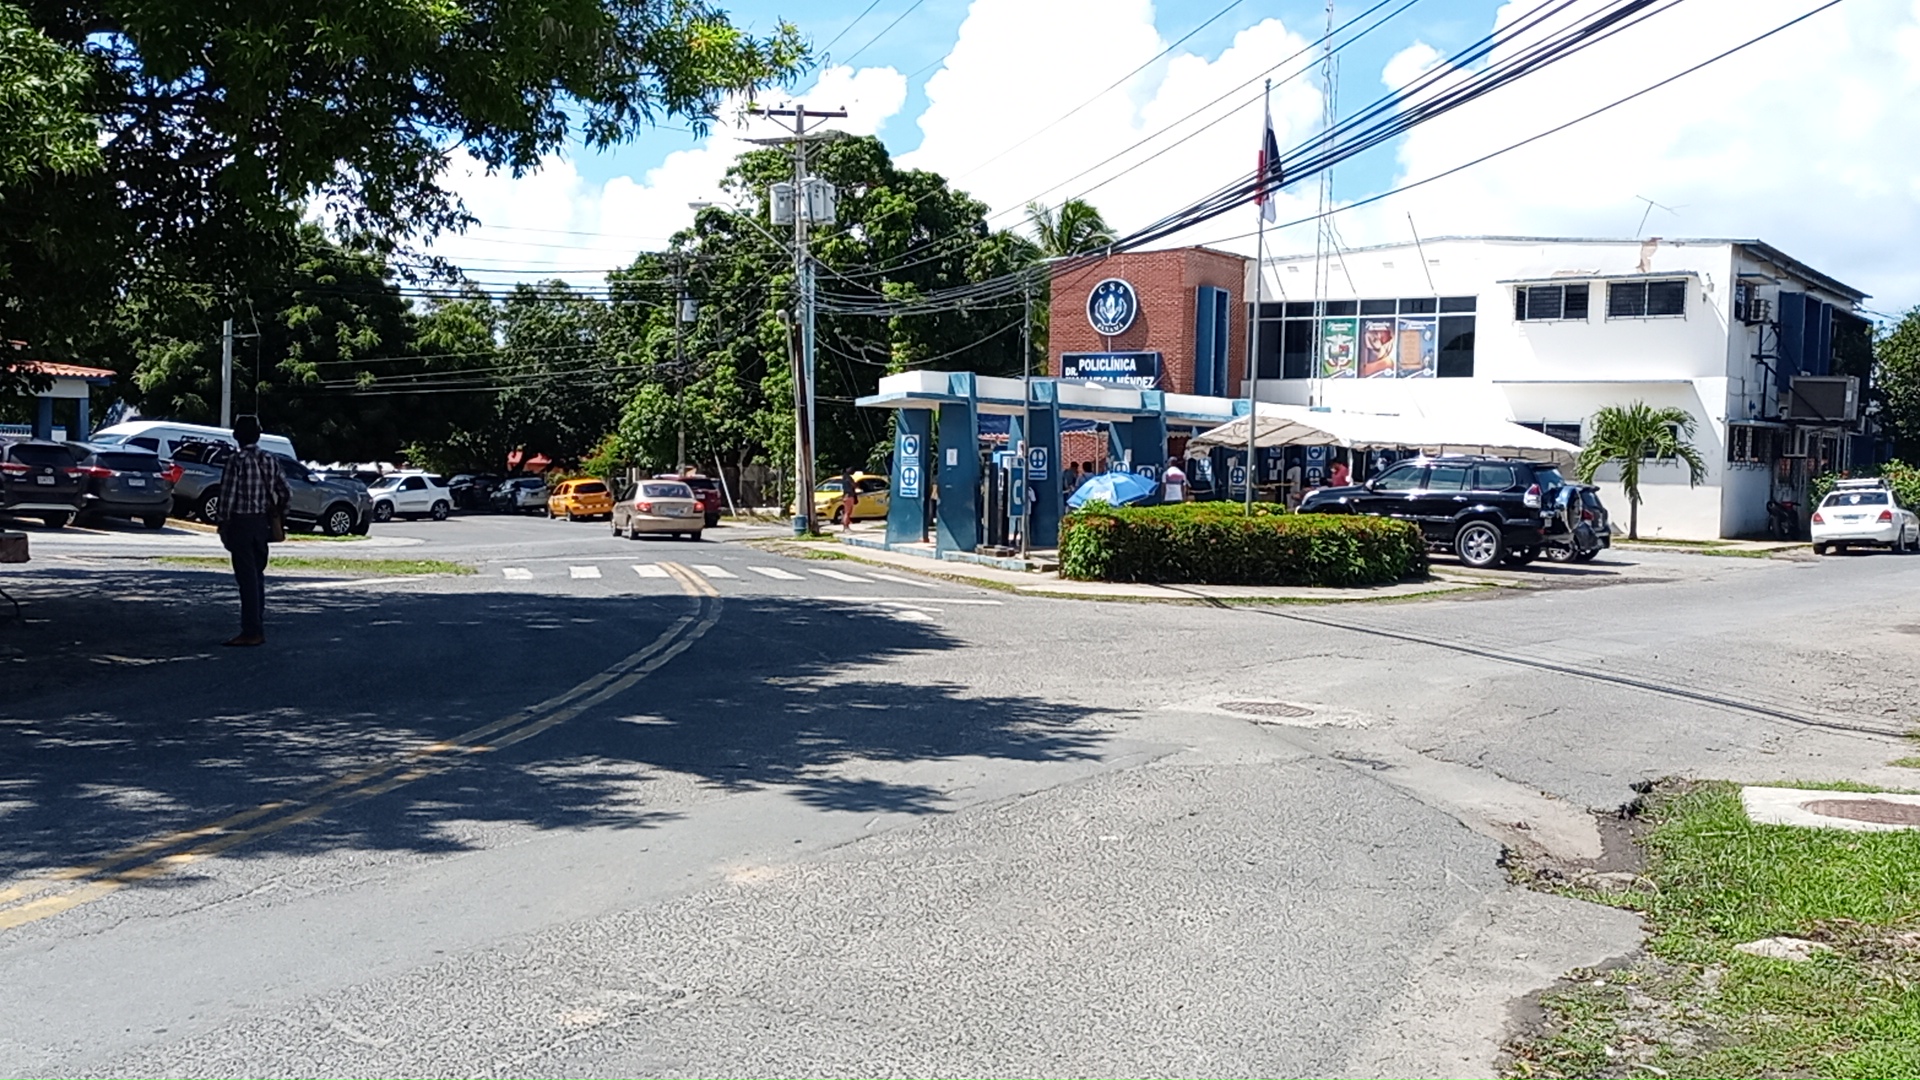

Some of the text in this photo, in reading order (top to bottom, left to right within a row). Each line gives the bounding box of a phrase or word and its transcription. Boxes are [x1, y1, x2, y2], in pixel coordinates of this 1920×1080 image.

[1098, 283, 1125, 294] CSS
[1079, 356, 1136, 371] POLICLÍNICA
[1065, 367, 1078, 376] DR.
[1117, 374, 1155, 388] MÉNDEZ
